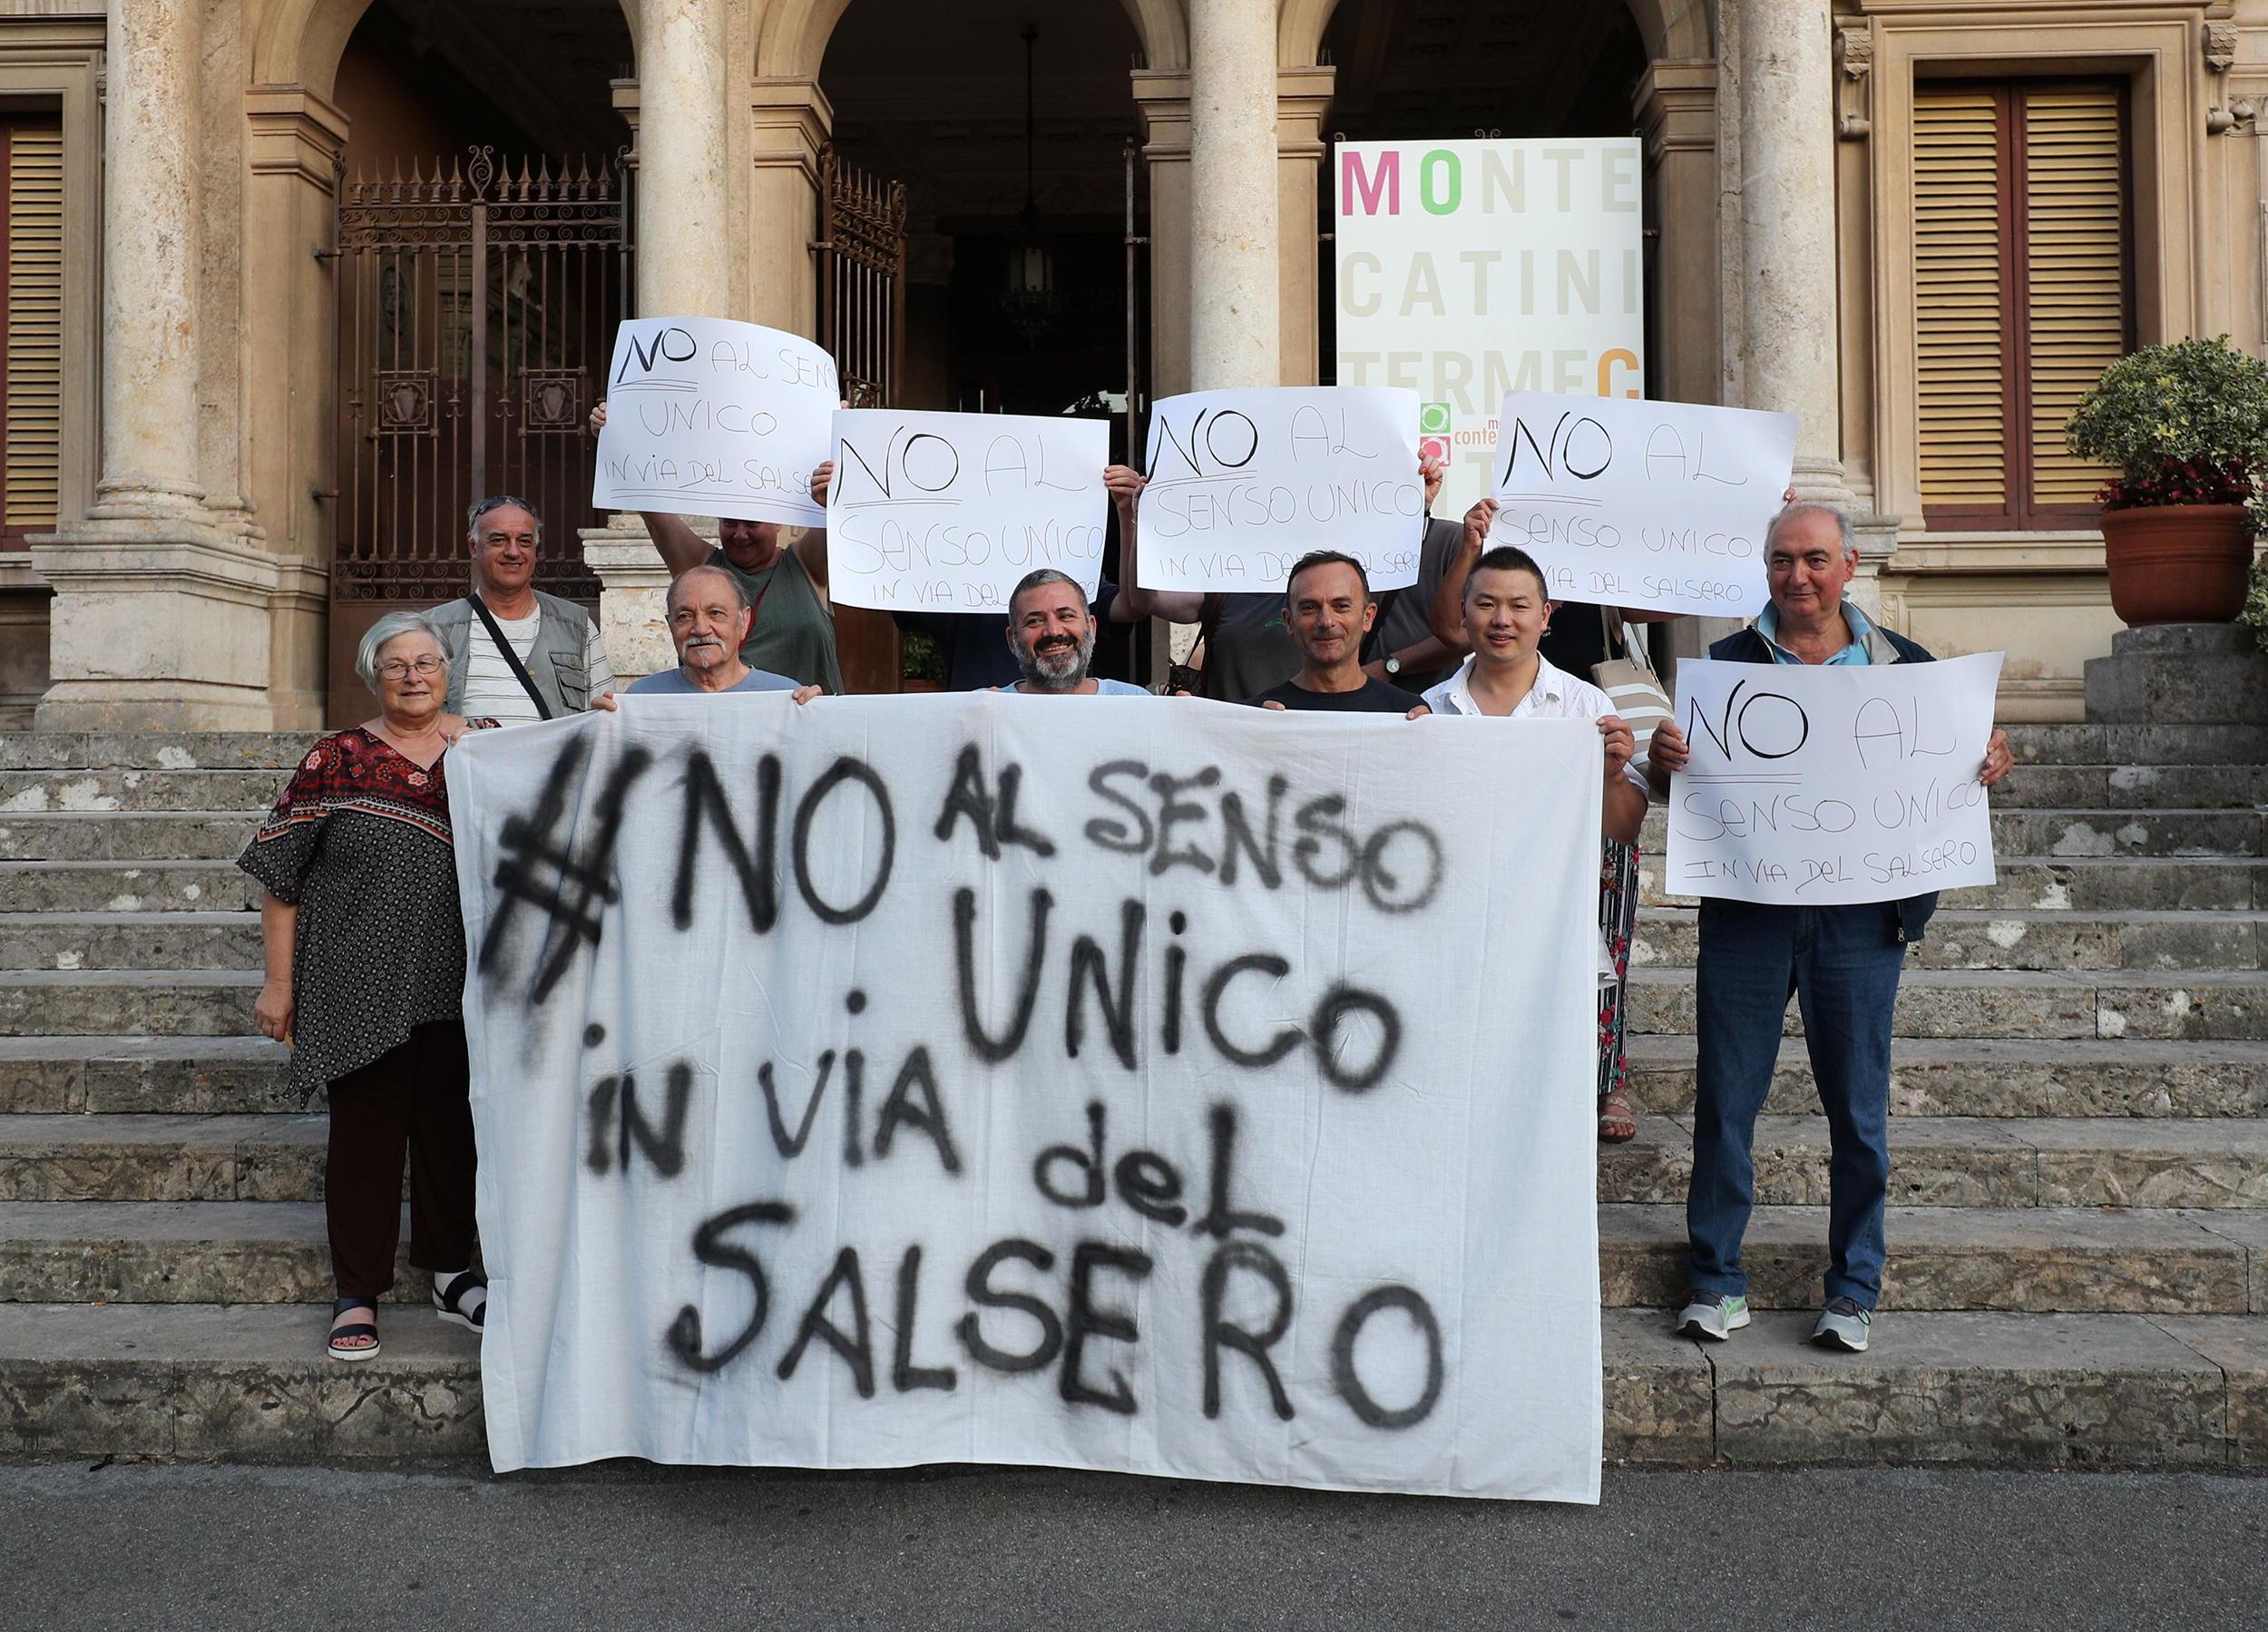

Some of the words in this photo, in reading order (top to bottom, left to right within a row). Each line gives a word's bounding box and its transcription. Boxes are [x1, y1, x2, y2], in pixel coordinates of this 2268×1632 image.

[1342, 149, 1636, 216] MONTE
[1340, 249, 1637, 318] CATINI
[617, 327, 697, 384] NO
[710, 340, 768, 379] AL
[640, 399, 777, 436] UNICO
[1147, 407, 1258, 484] NO
[1291, 406, 1378, 462] AL
[1454, 429, 1497, 445] conte
[604, 454, 630, 481] IN
[833, 425, 959, 506] NO
[984, 435, 1088, 495] AL
[1501, 411, 1613, 489] NO
[1646, 424, 1748, 485] AL
[1154, 484, 1295, 537] SENSO
[1307, 479, 1422, 523] UNICO
[1002, 519, 1104, 566] UNICO
[1159, 552, 1188, 578] IN
[1198, 552, 1245, 578] VIA
[1641, 528, 1753, 558] UNICO
[872, 579, 901, 601] IN
[913, 580, 953, 603] VIA
[1685, 679, 1808, 764] NO
[1853, 697, 1956, 769] AL
[1873, 777, 1982, 829] UNICO
[480, 737, 894, 1005] #NO
[934, 741, 1056, 860] AL
[1083, 758, 1442, 913] SENSO
[1684, 860, 1737, 879] IN
[1745, 858, 1787, 884] VIA
[666, 1201, 1445, 1429] SALSERO
